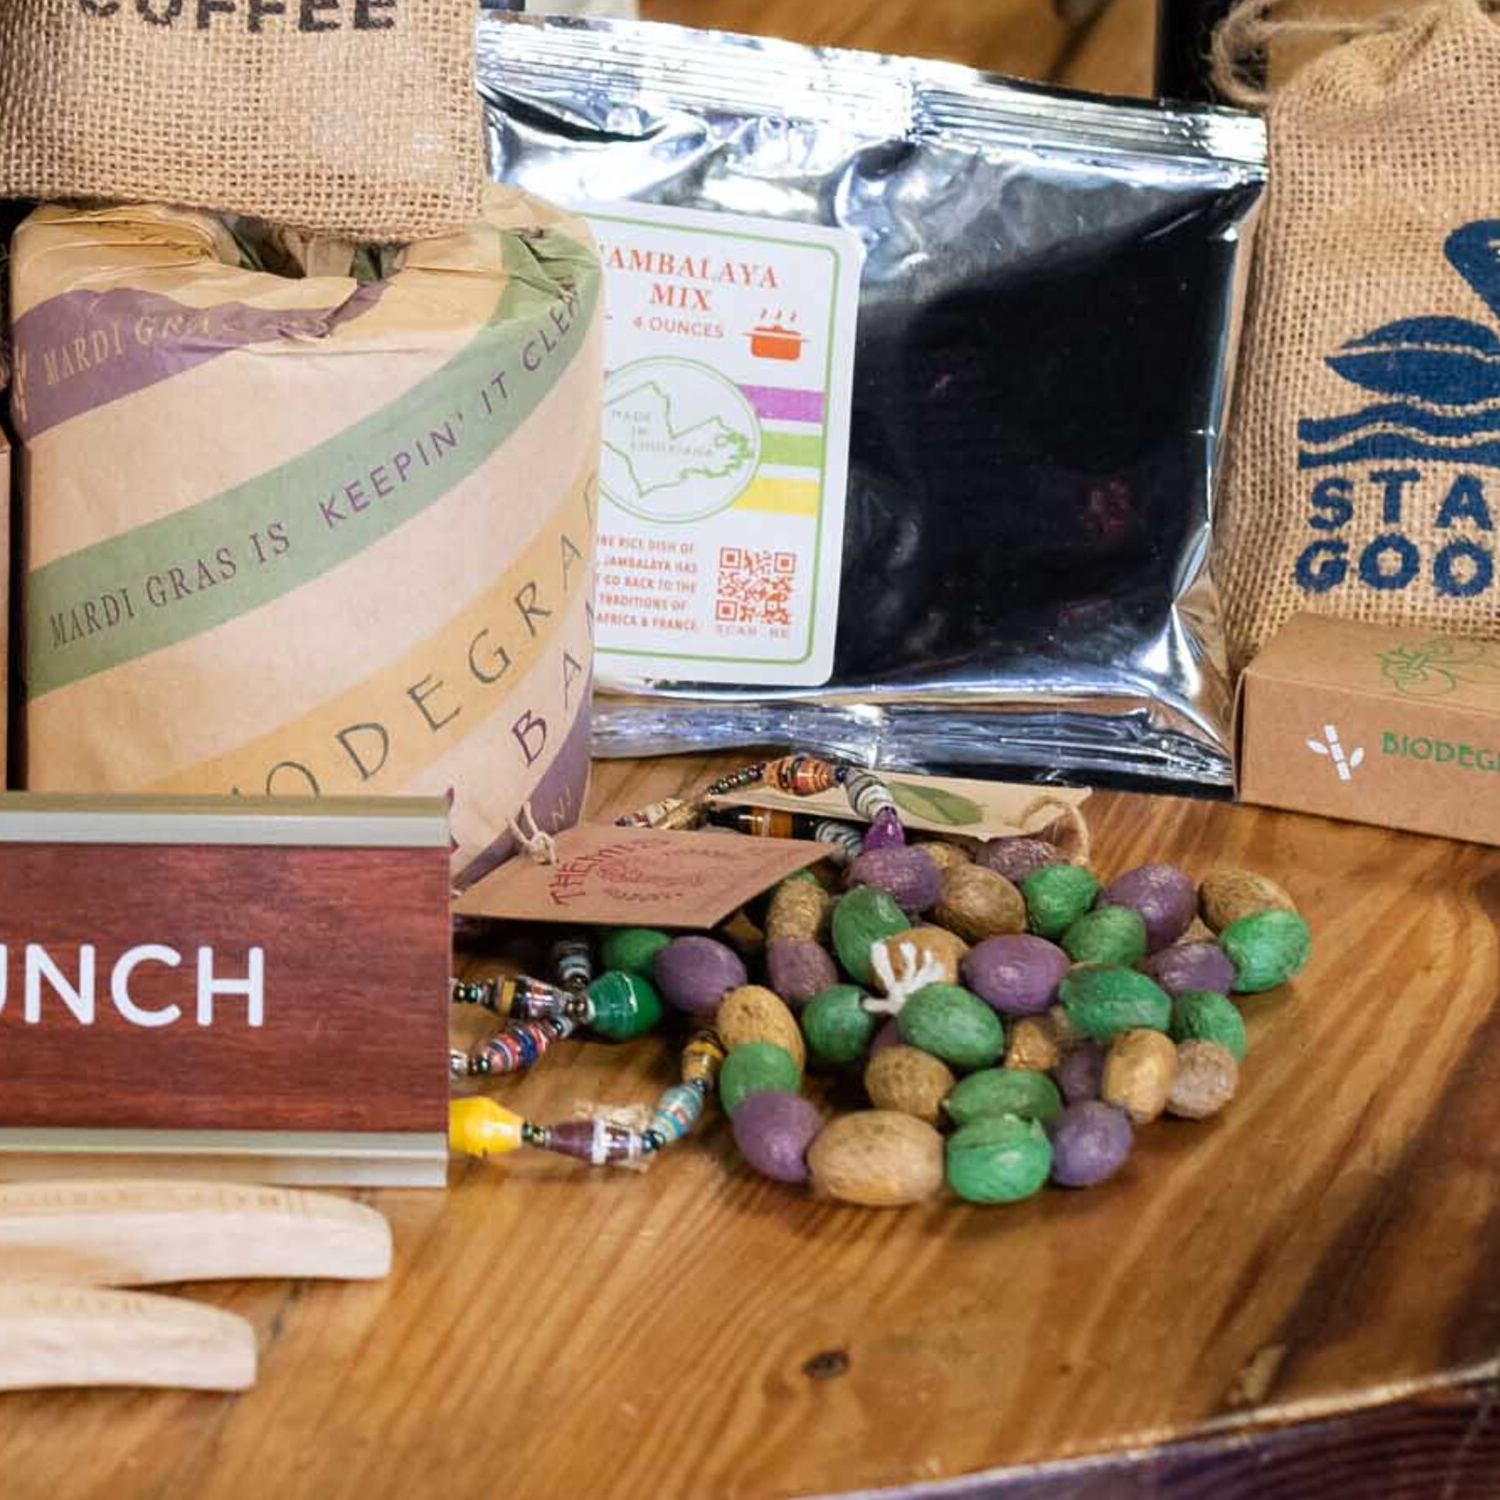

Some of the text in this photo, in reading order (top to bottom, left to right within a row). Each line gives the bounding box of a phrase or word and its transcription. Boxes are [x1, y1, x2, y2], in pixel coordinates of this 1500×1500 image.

[599, 244, 778, 289] AMBALAYA
[651, 283, 712, 312] MIX
[632, 316, 724, 339] 4 OUNCES
[43, 318, 124, 387] MARDI
[49, 589, 132, 650] MARDI
[146, 546, 237, 608] GRAS
[250, 521, 291, 563] IS
[479, 370, 512, 418] IT
[1381, 731, 1500, 772] BIODEG
